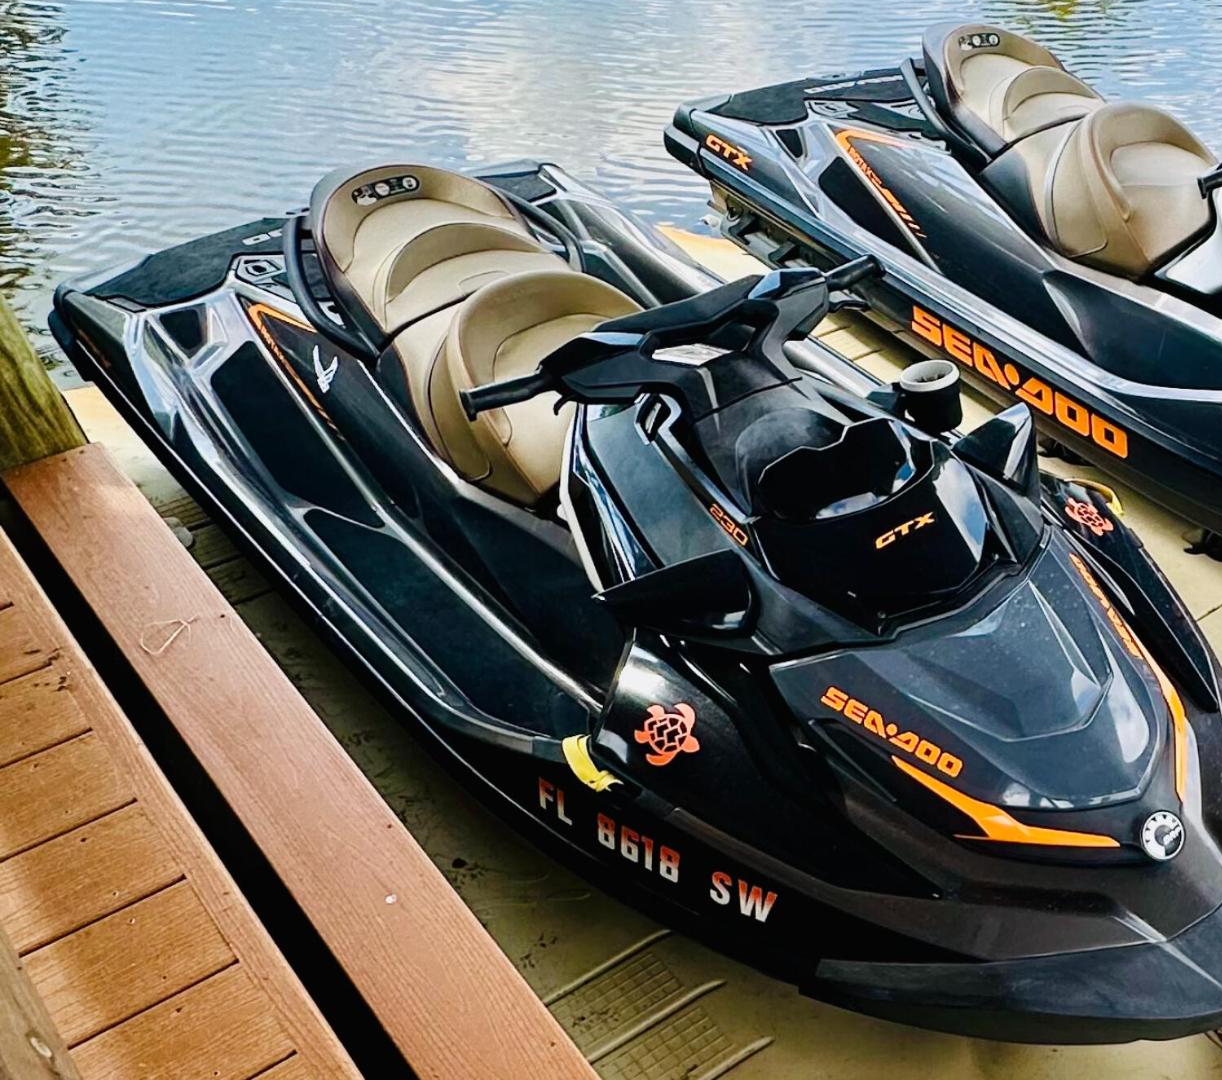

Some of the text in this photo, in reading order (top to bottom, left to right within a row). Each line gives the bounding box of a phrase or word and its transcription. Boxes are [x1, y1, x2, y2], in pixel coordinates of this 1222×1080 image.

[705, 133, 753, 171] GTX
[709, 503, 749, 547] 230
[875, 511, 936, 550] GTX
[538, 776, 778, 923] FL 8618 SW
